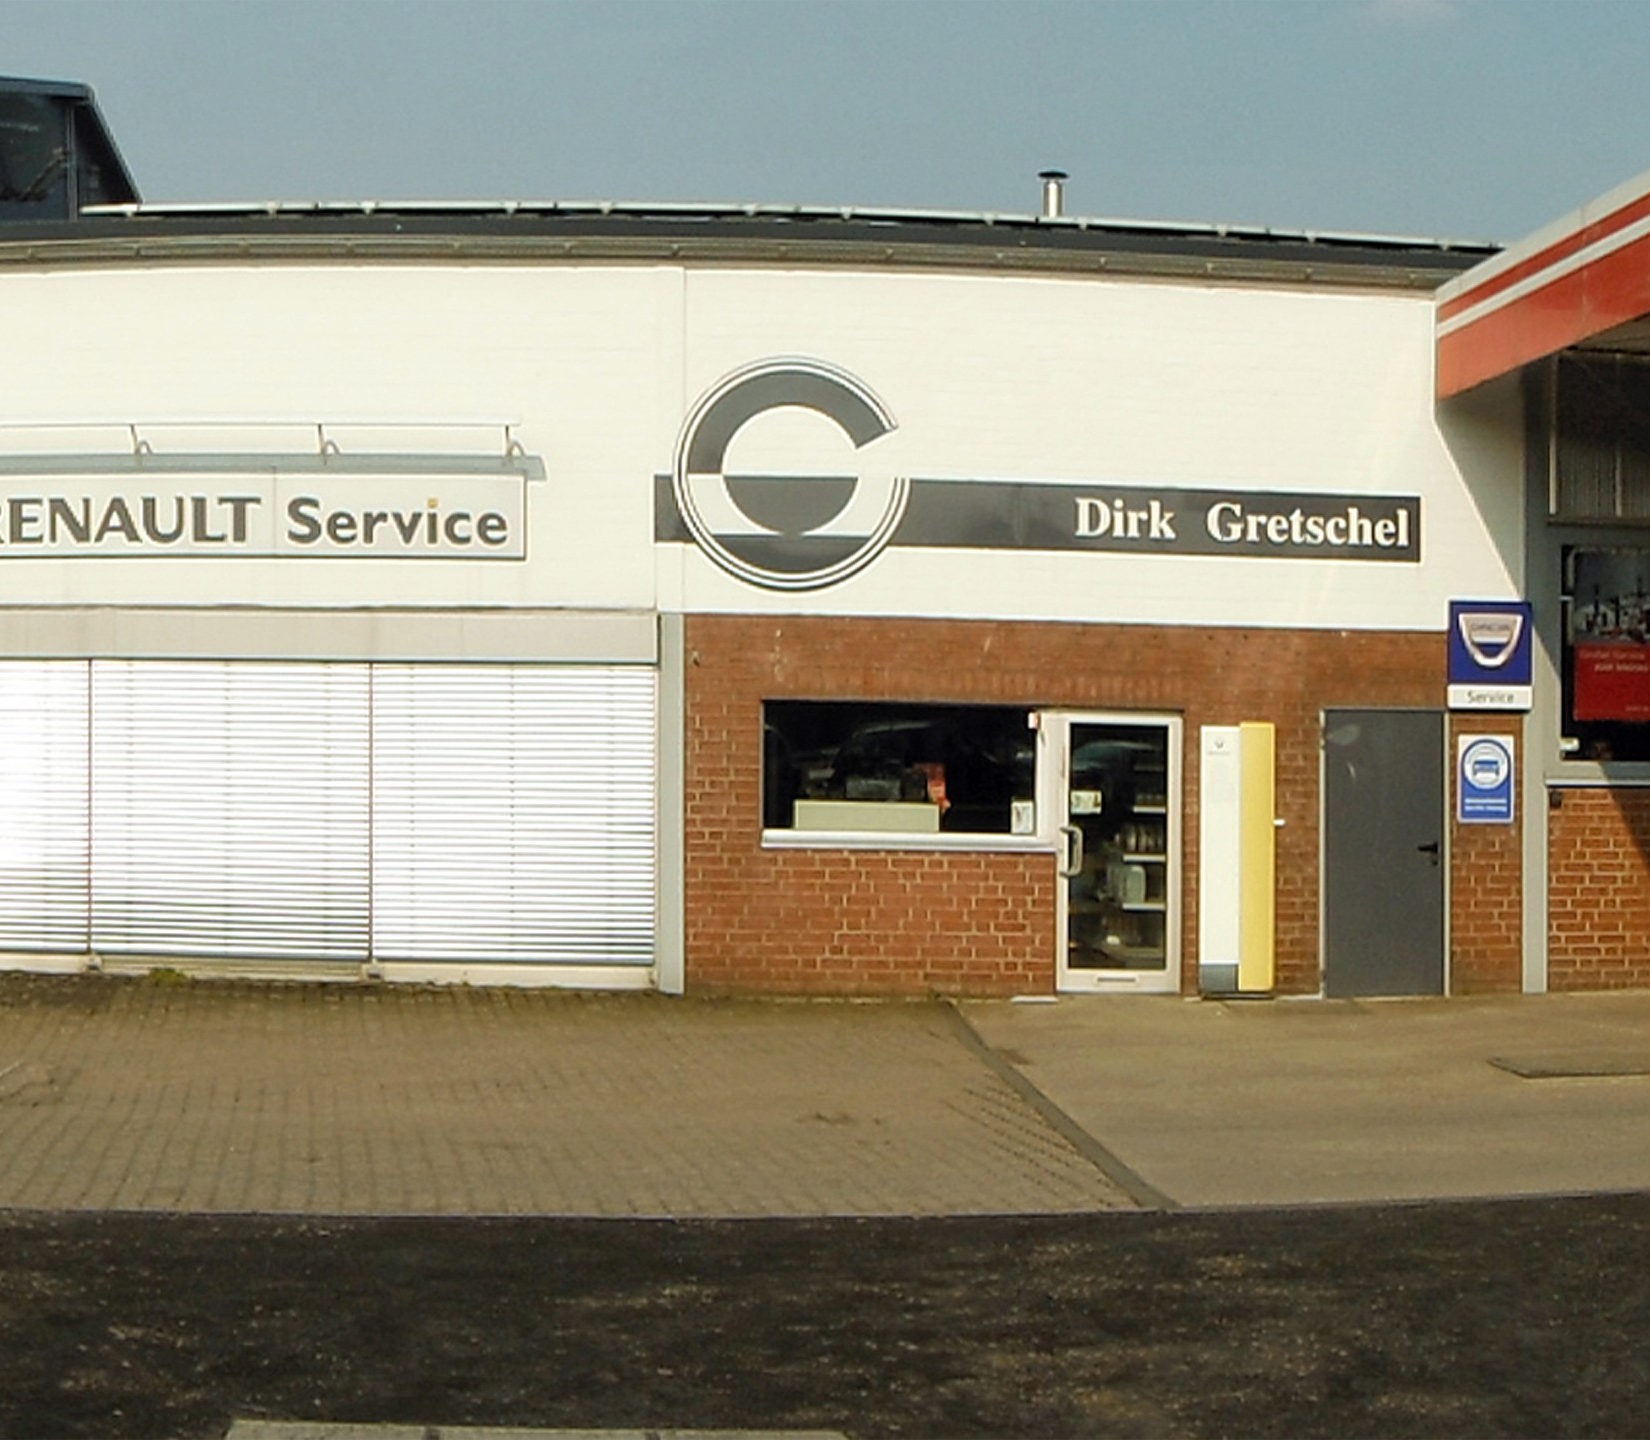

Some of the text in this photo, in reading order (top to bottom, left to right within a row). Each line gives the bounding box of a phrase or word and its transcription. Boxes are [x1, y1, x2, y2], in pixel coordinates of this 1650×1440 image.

[287, 497, 509, 546] Service
[1074, 496, 1411, 548] Dirk Gretschel
[1467, 689, 1515, 704] Service
